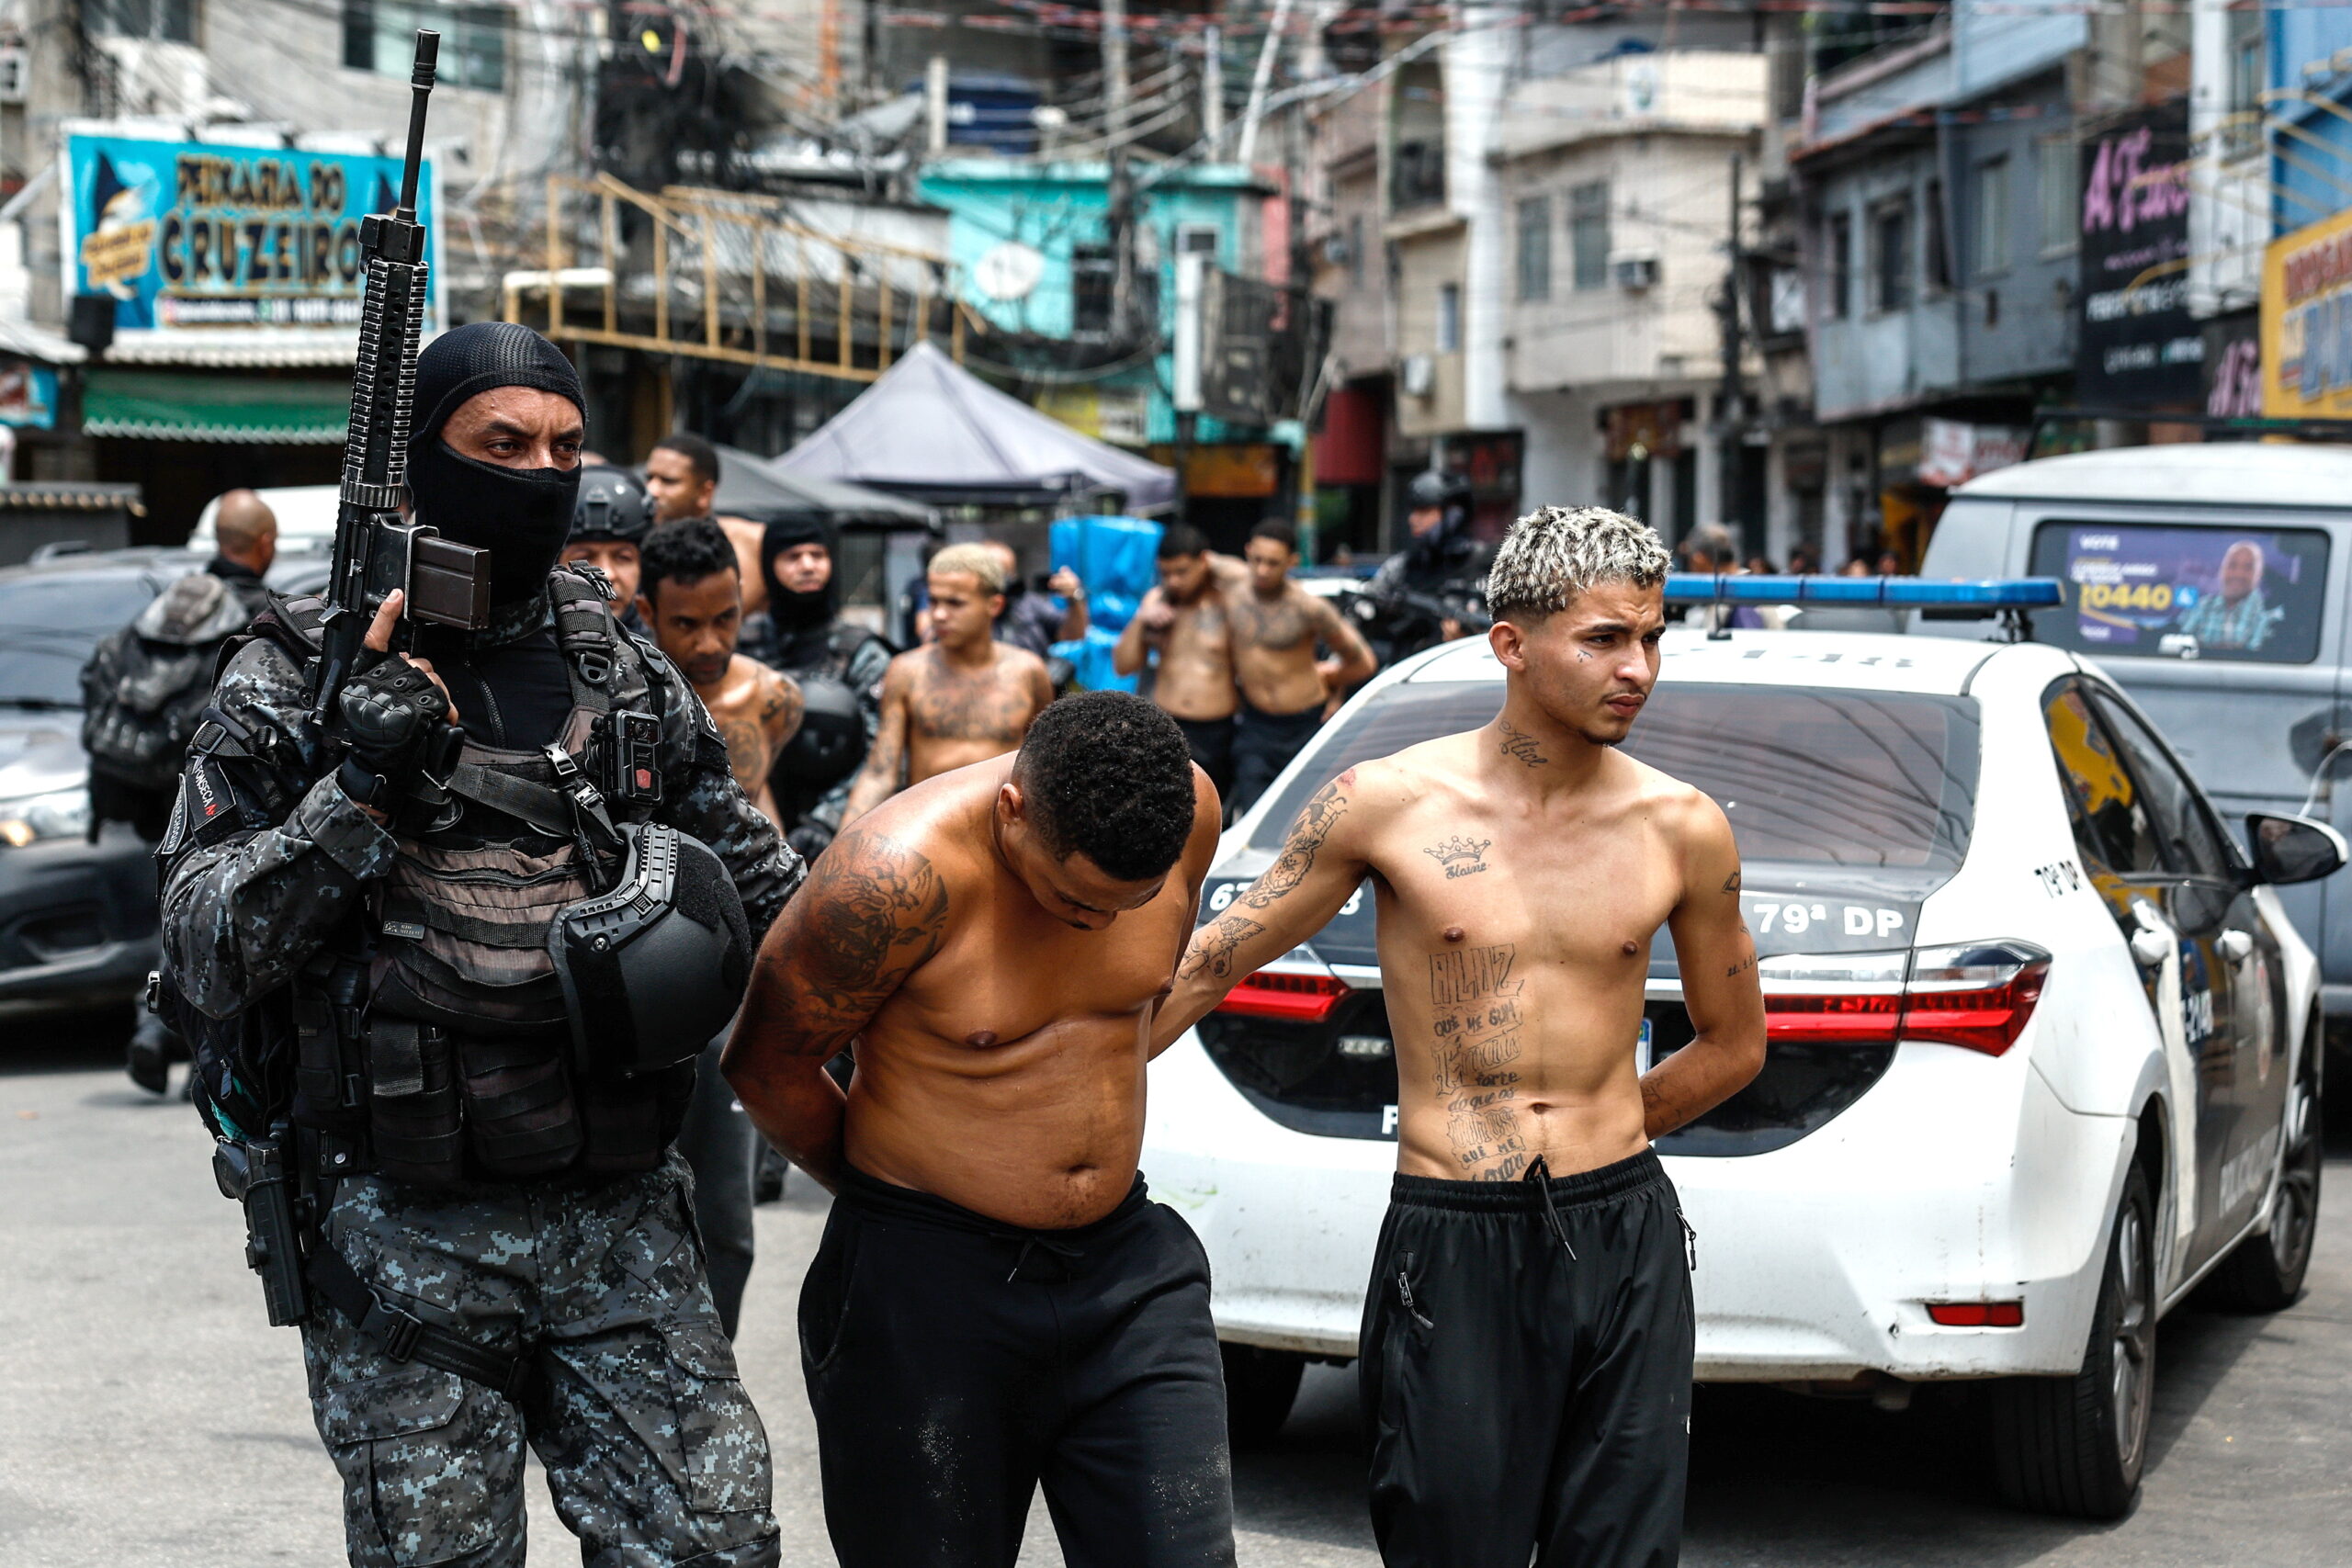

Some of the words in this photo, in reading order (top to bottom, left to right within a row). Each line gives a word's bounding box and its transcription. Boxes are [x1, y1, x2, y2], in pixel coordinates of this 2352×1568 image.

[309, 160, 345, 215] DO
[158, 211, 361, 287] CRUZEIRO
[2080, 582, 2172, 611] 10440
[1498, 716, 1549, 768] Alice
[194, 764, 215, 808] FONSECA
[1843, 906, 1905, 938] DP
[1462, 1145, 1487, 1164] QUE
